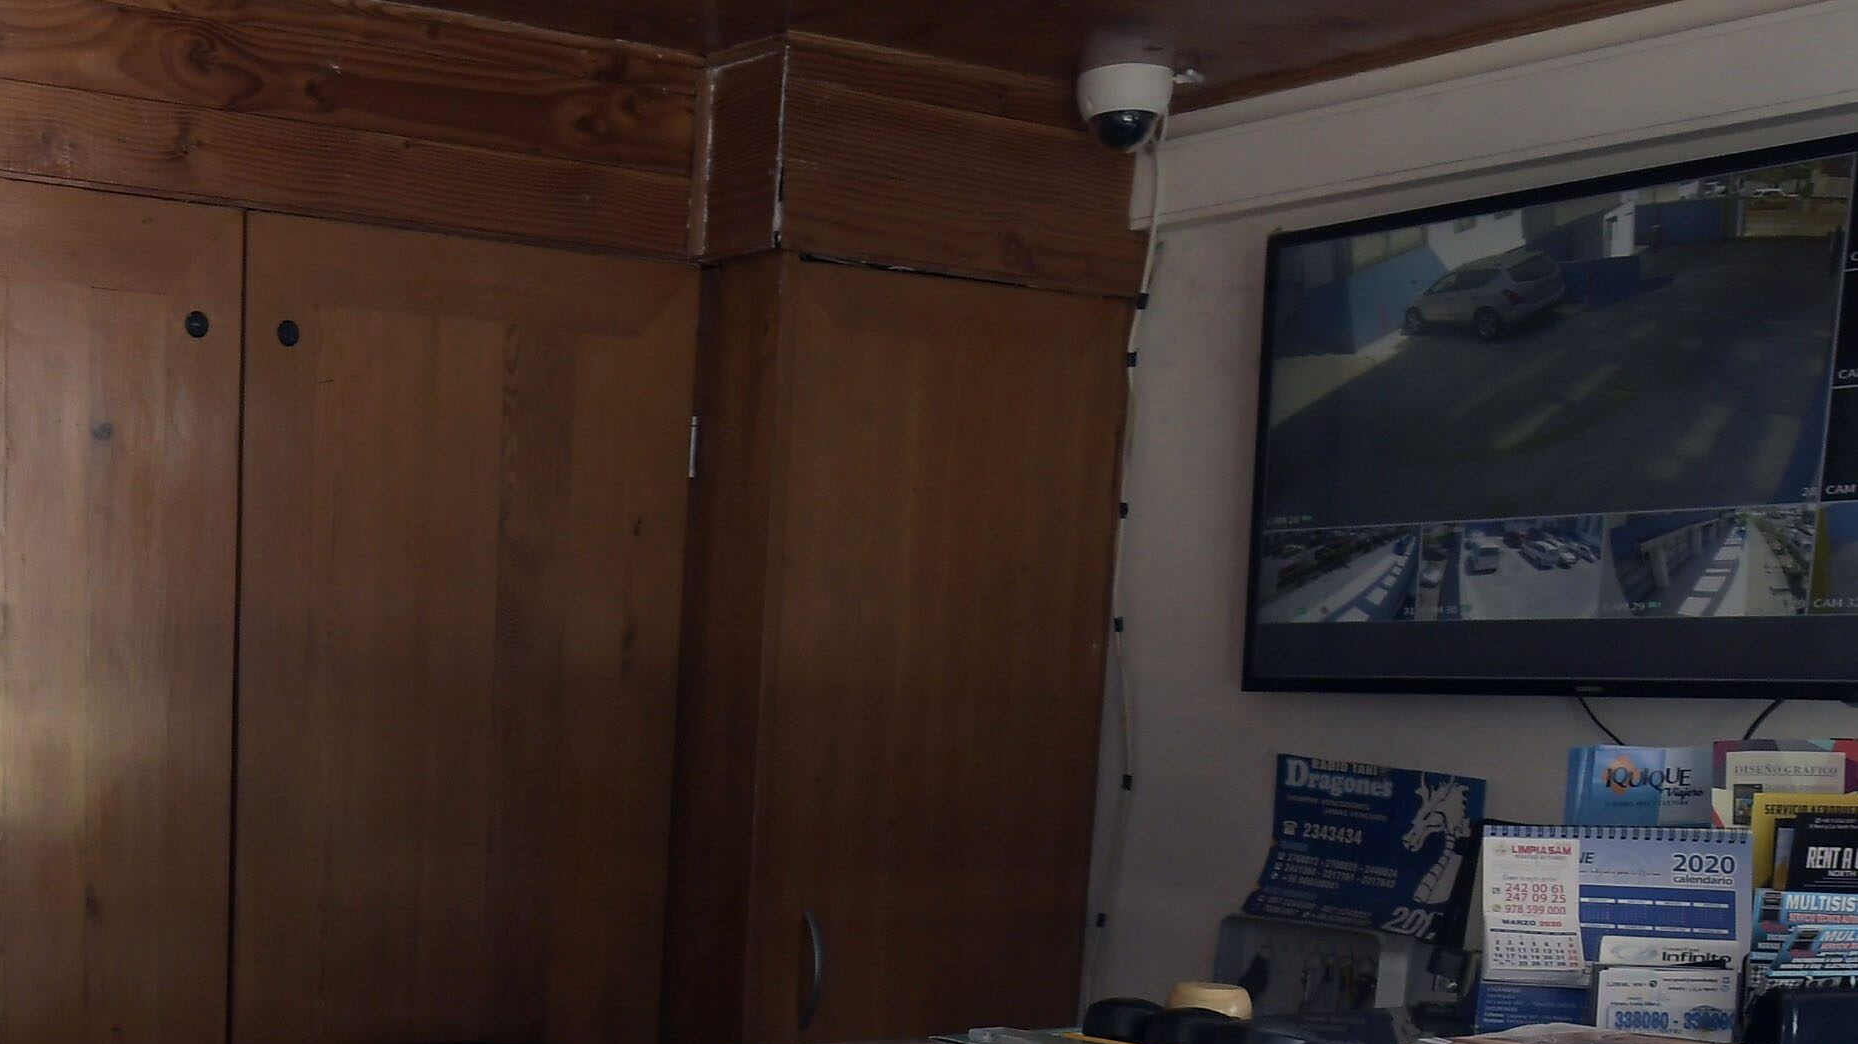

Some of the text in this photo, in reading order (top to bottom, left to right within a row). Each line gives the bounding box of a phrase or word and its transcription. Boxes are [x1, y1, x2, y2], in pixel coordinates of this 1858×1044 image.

[1285, 759, 1394, 797] Dragones
[1606, 767, 1692, 792] IQUIQUE
[1303, 822, 1363, 845] 2343434
[1511, 845, 1572, 855] LIMPIASAM
[1806, 846, 1853, 869] RENT A
[1673, 854, 1735, 874] 2020
[1505, 883, 1564, 893] 242 00 61
[1673, 876, 1733, 886] calendario
[1505, 893, 1566, 903] 247 09 25
[1505, 905, 1566, 915] 978 599 000
